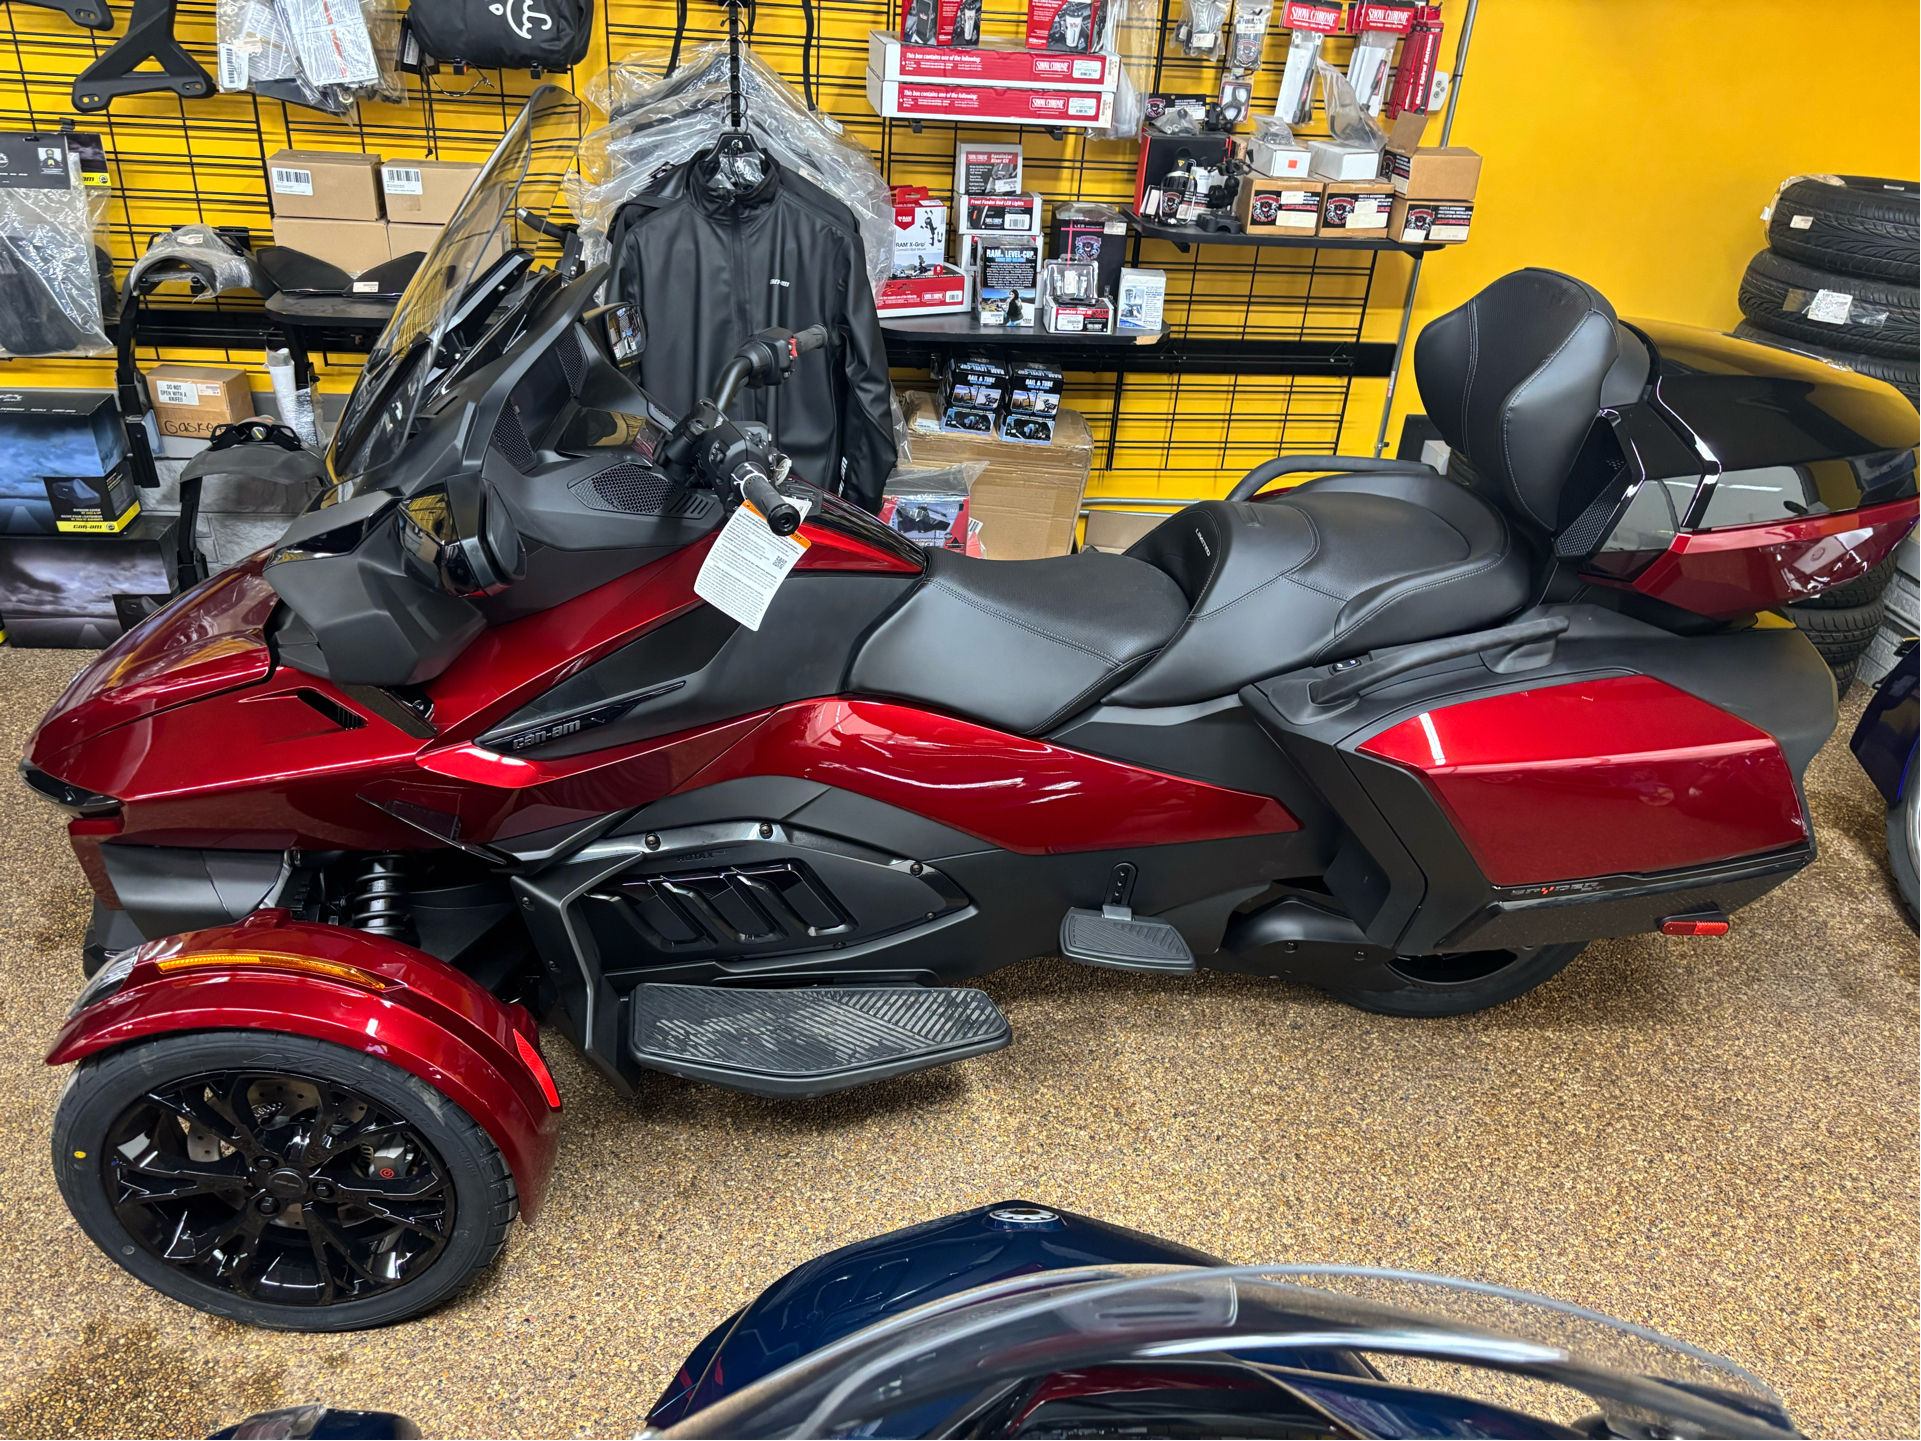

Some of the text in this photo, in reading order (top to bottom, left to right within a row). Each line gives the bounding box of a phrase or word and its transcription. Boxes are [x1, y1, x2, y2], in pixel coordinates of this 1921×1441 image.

[1290, 6, 1337, 26] SHOW CHROME
[1367, 8, 1409, 25] SHOW CHROME
[1424, 34, 1433, 63] Antenna
[987, 249, 1001, 257] RAM
[1195, 528, 1211, 556] LIMITED
[513, 719, 580, 750] can-am
[677, 852, 714, 863] ROTAX
[1509, 882, 1600, 896] SPYDER
